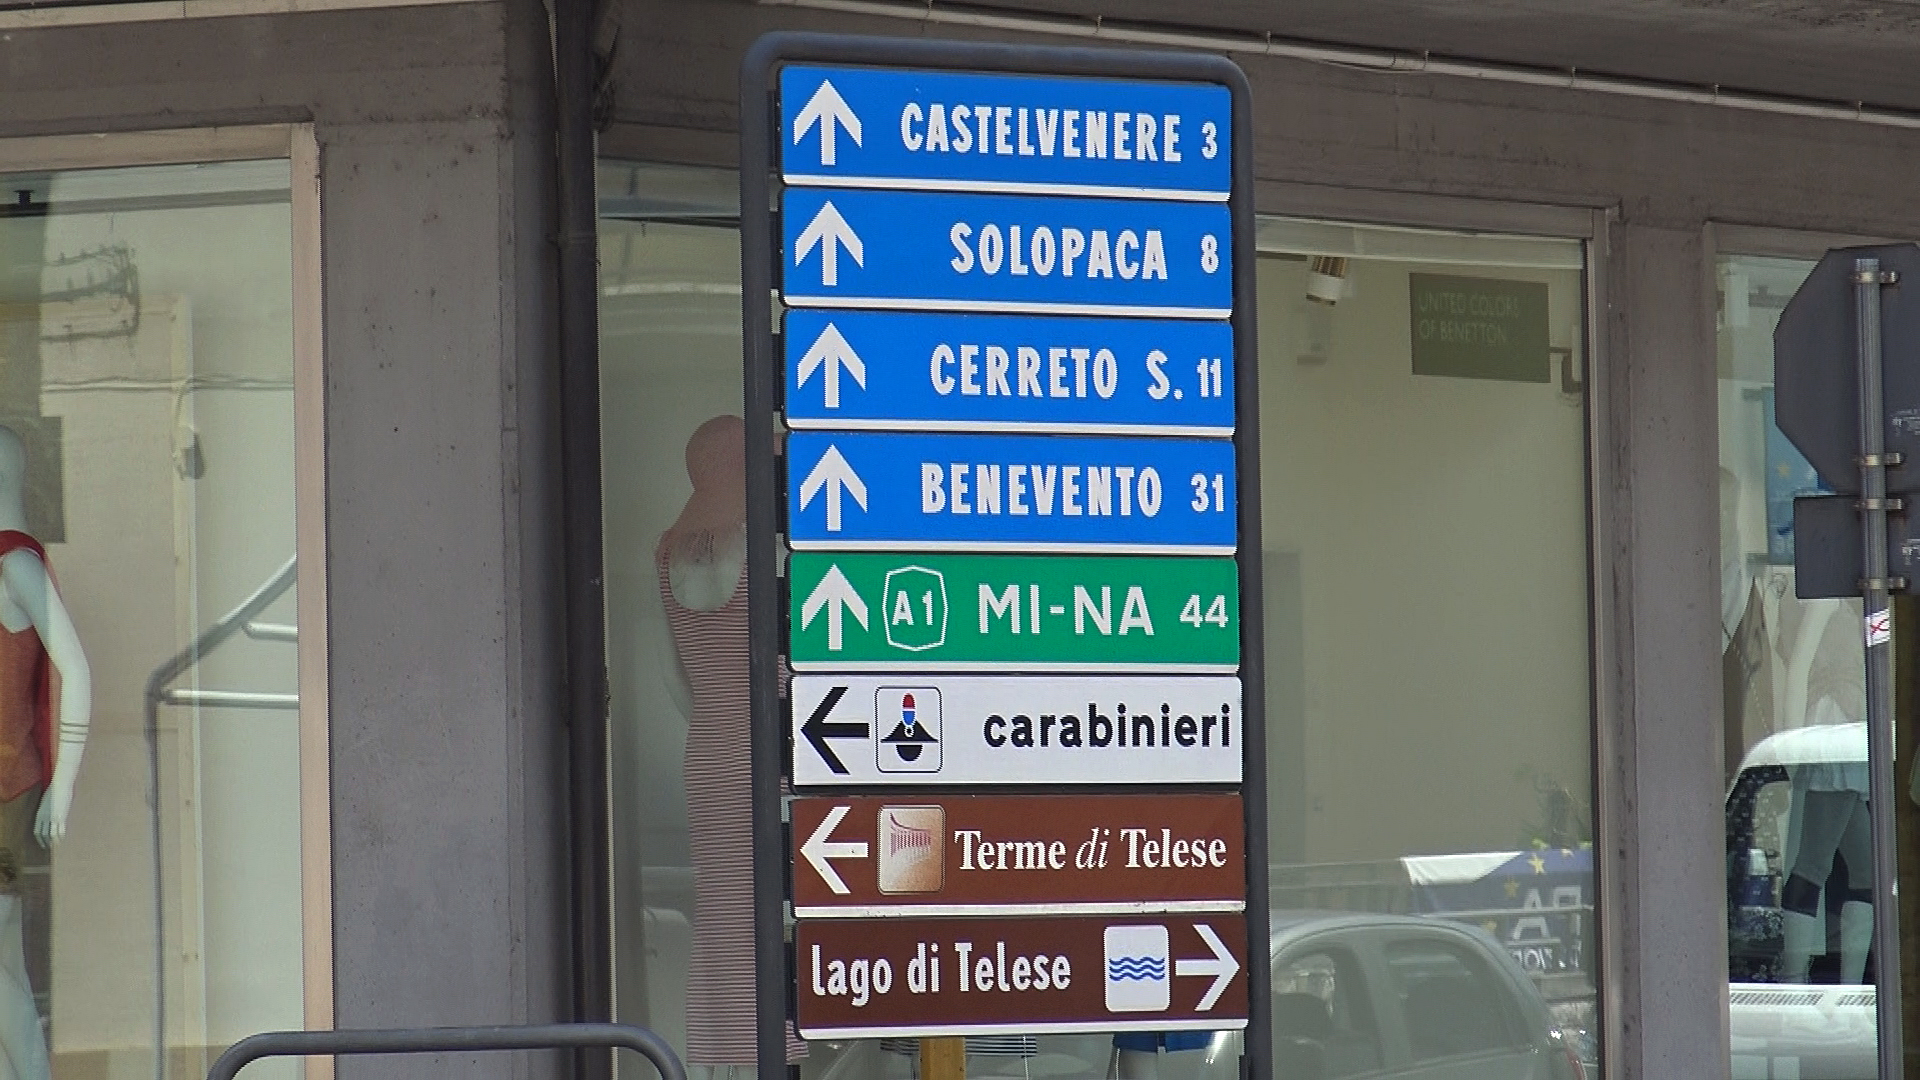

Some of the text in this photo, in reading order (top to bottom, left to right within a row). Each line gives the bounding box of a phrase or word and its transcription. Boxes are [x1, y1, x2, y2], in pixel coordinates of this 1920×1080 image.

[900, 102, 1218, 162] CASTELVENERE 3
[949, 222, 1220, 280] SOLOPACA 8
[1418, 291, 1520, 318] UNITED COLORS
[1418, 319, 1507, 344] OF BENETTON
[929, 344, 1222, 400] CERRETO S. 11
[921, 462, 1225, 518] BENEVENTO 31
[891, 584, 1229, 636] A1 MI-NA 44
[983, 702, 1231, 748] carabinieri
[953, 827, 1227, 870] Terme di Telese
[811, 941, 1071, 1007] lago di Telese
